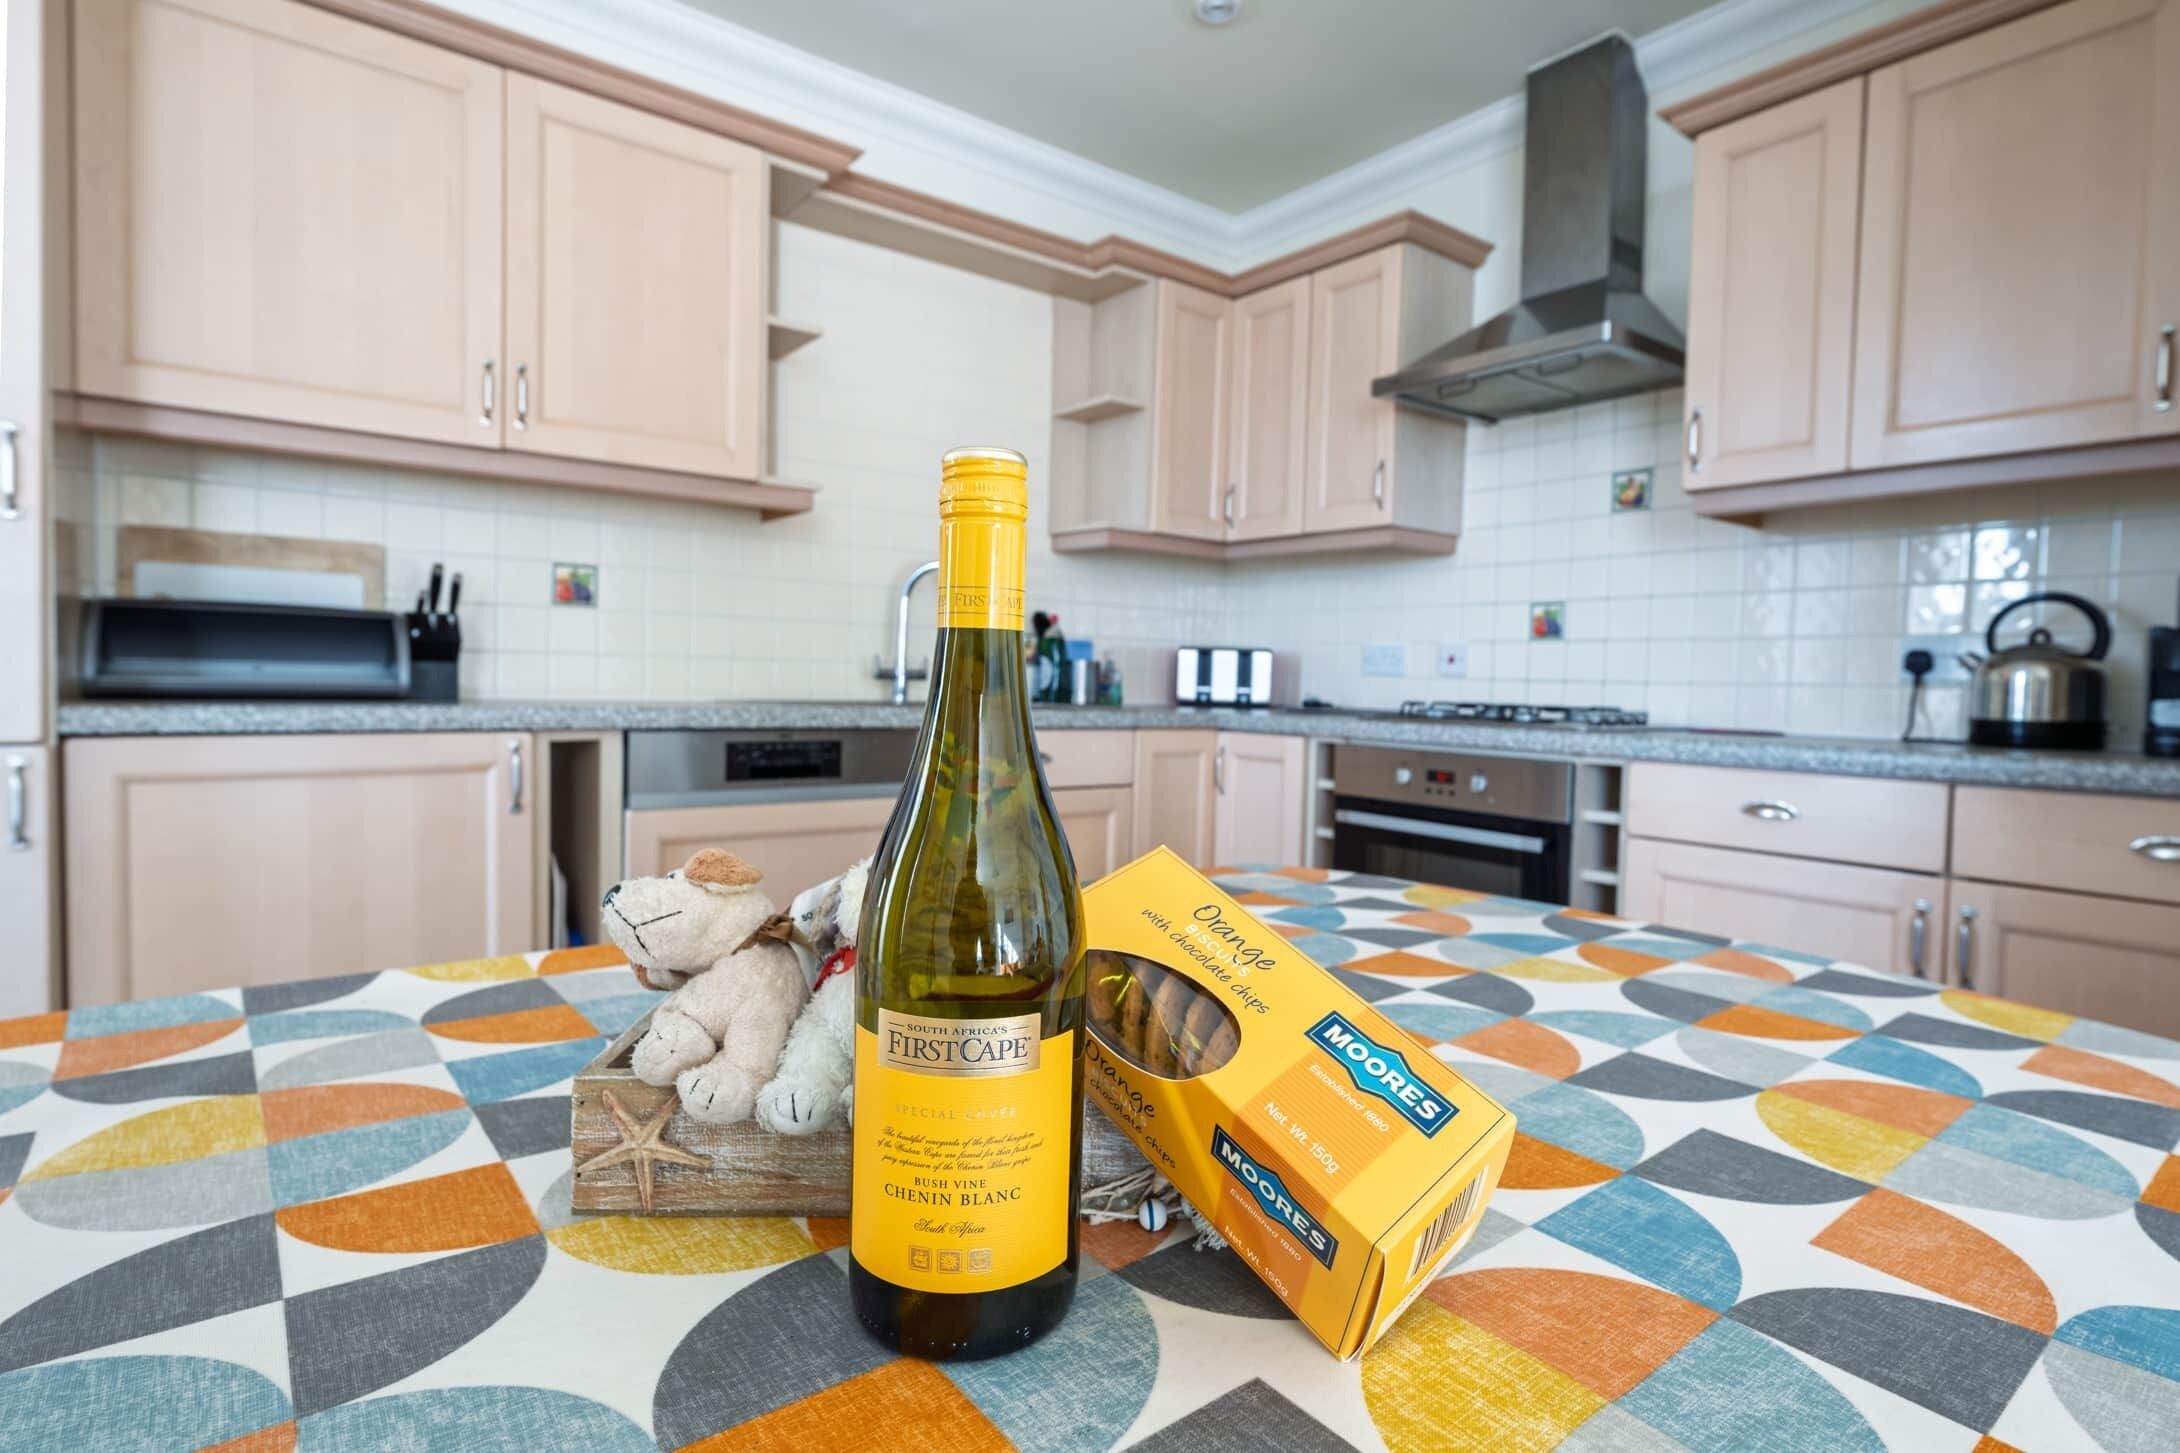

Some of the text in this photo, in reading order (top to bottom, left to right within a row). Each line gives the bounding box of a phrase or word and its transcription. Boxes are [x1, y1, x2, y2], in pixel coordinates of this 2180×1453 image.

[1141, 909, 1271, 1014] with chocolate chips
[1193, 904, 1277, 971] Orange
[907, 1023, 1008, 1036] SOUTH AFRICA'S
[1085, 1039, 1156, 1118] Orange
[1323, 1023, 1443, 1121] MOORES
[1309, 1063, 1391, 1133] Established 1880
[1144, 1135, 1177, 1170] chips
[1309, 1141, 1340, 1175] 150g
[884, 1183, 1021, 1206] CHENIN BLANC
[914, 1176, 988, 1189] BUSH VINE
[1221, 1141, 1326, 1251] MOORES
[913, 1216, 987, 1239] South Africa
